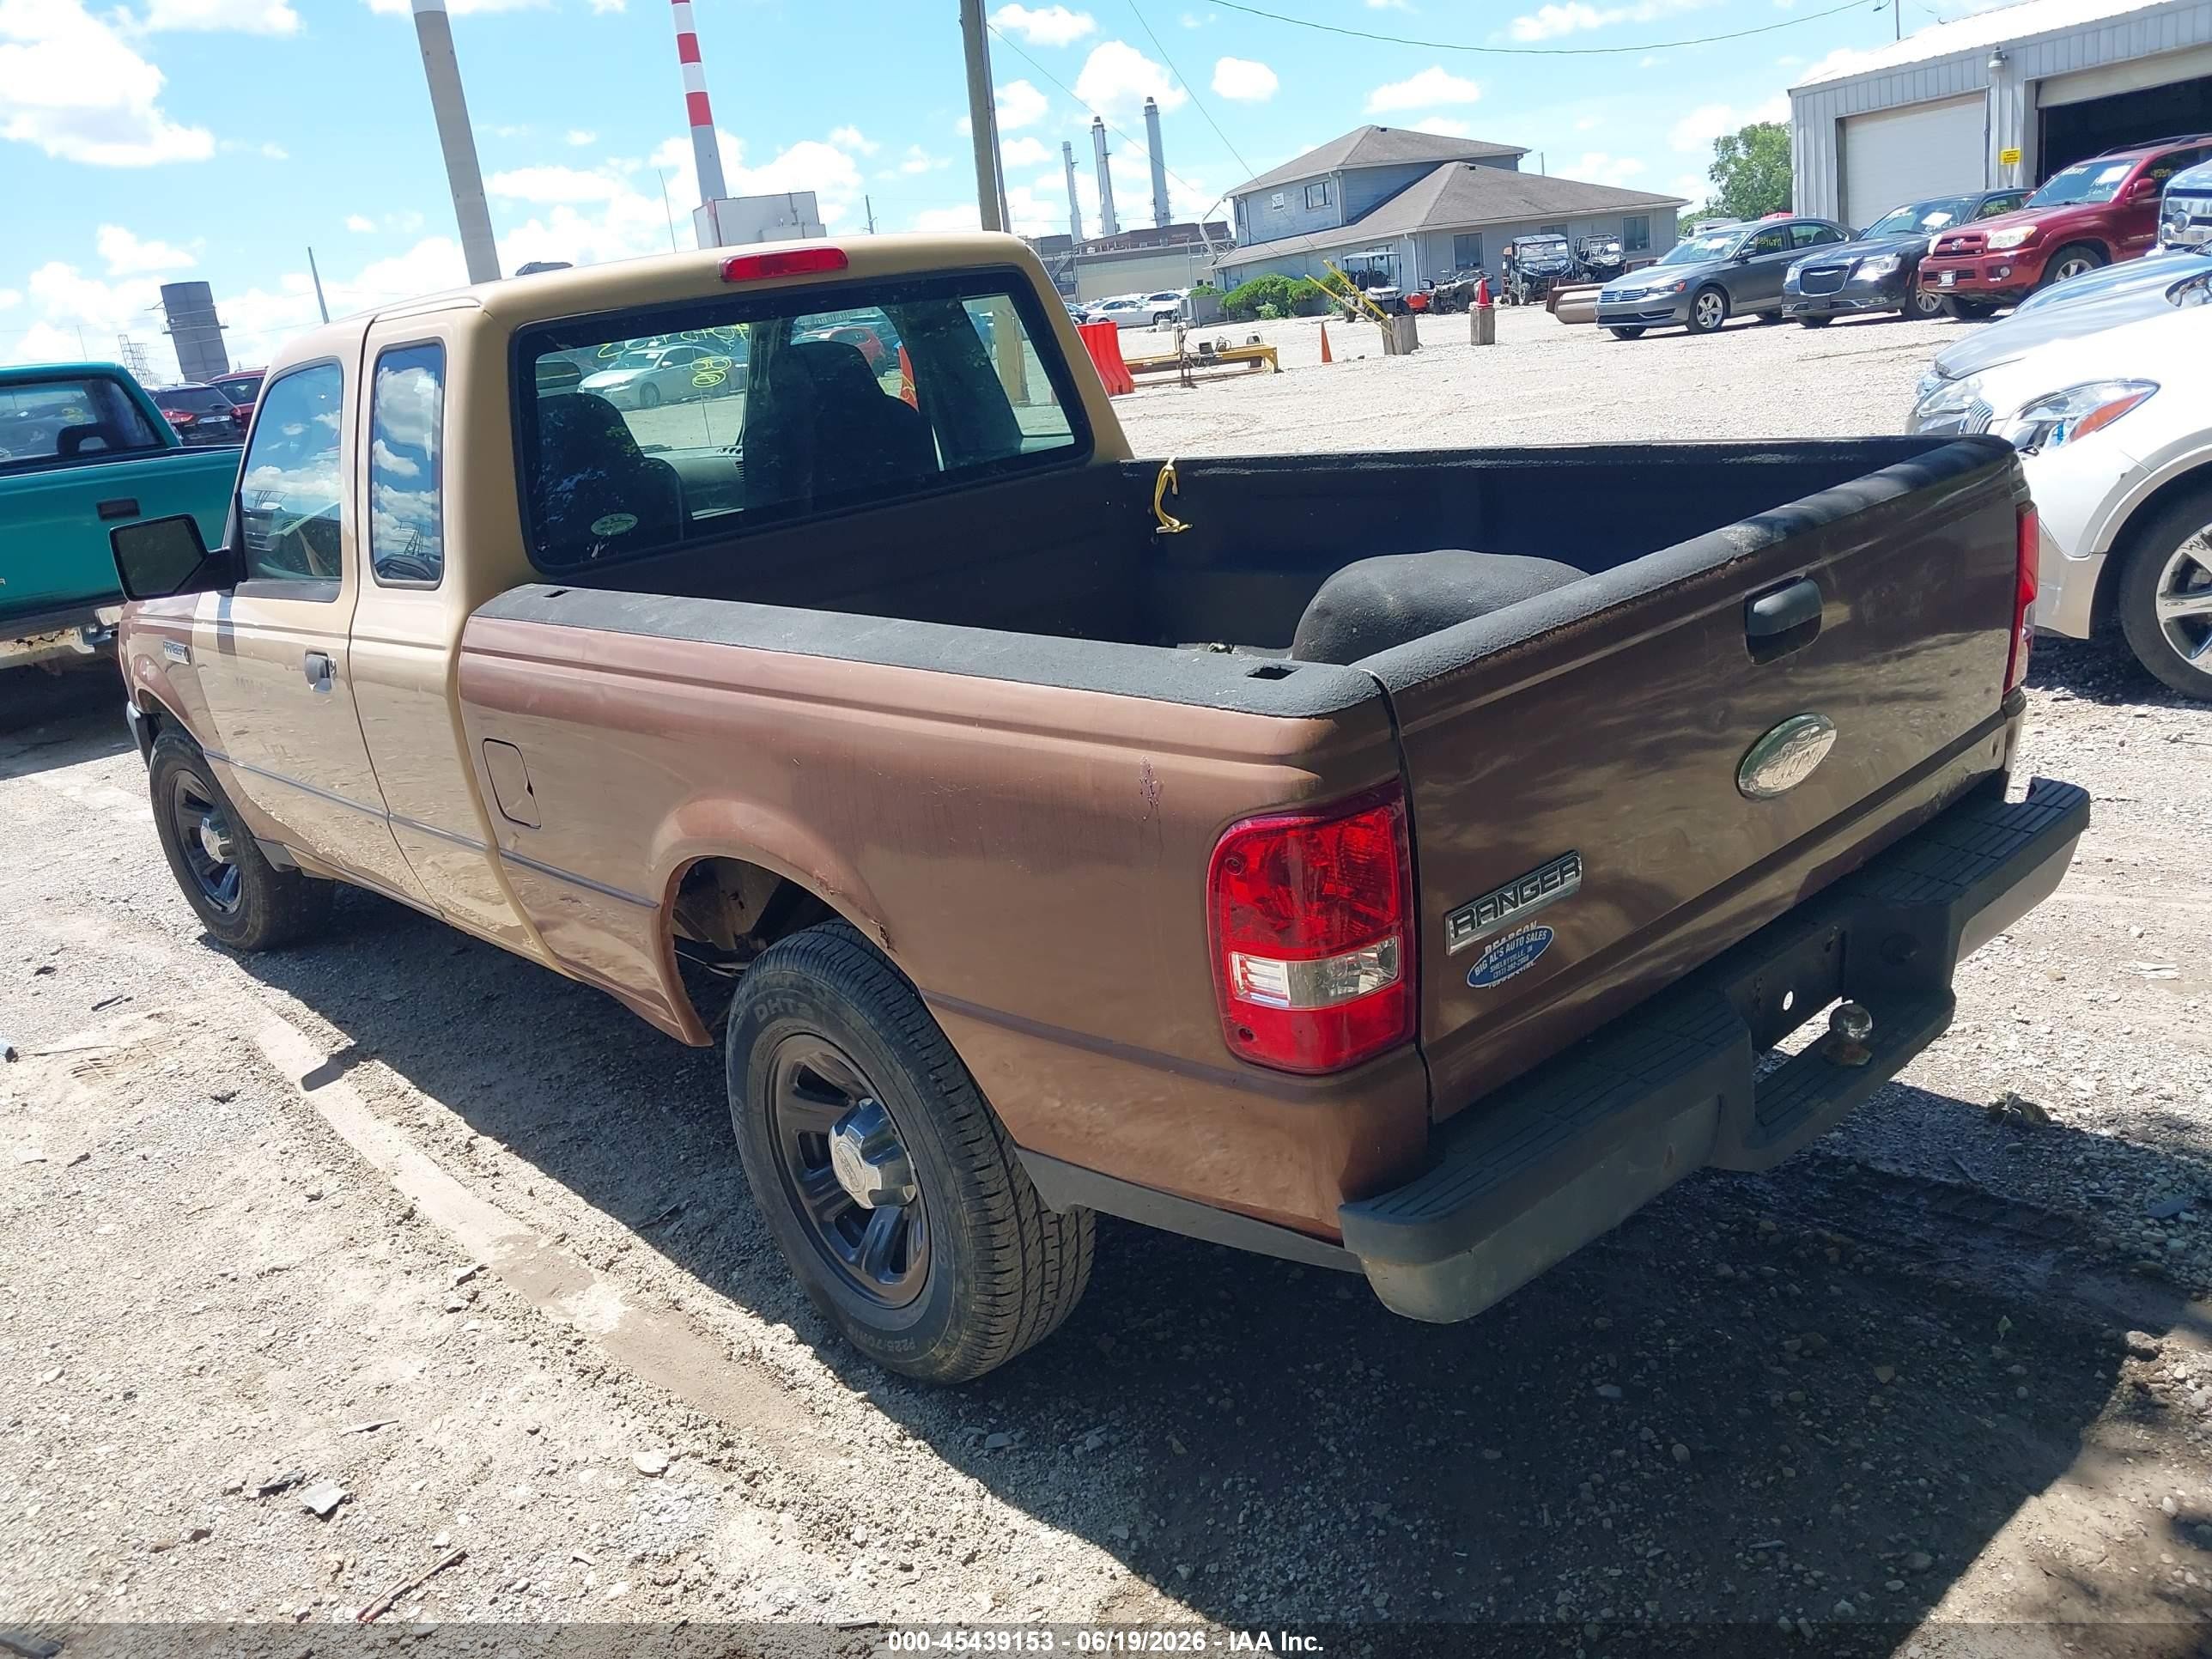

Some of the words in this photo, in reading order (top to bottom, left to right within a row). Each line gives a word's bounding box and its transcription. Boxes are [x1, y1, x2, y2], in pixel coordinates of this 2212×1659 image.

[1451, 856, 1581, 939] RANGER
[1474, 959, 1488, 976] BIG
[1489, 946, 1504, 964] AL'S
[1505, 935, 1524, 953] AUTO
[1525, 929, 1547, 945] SALES
